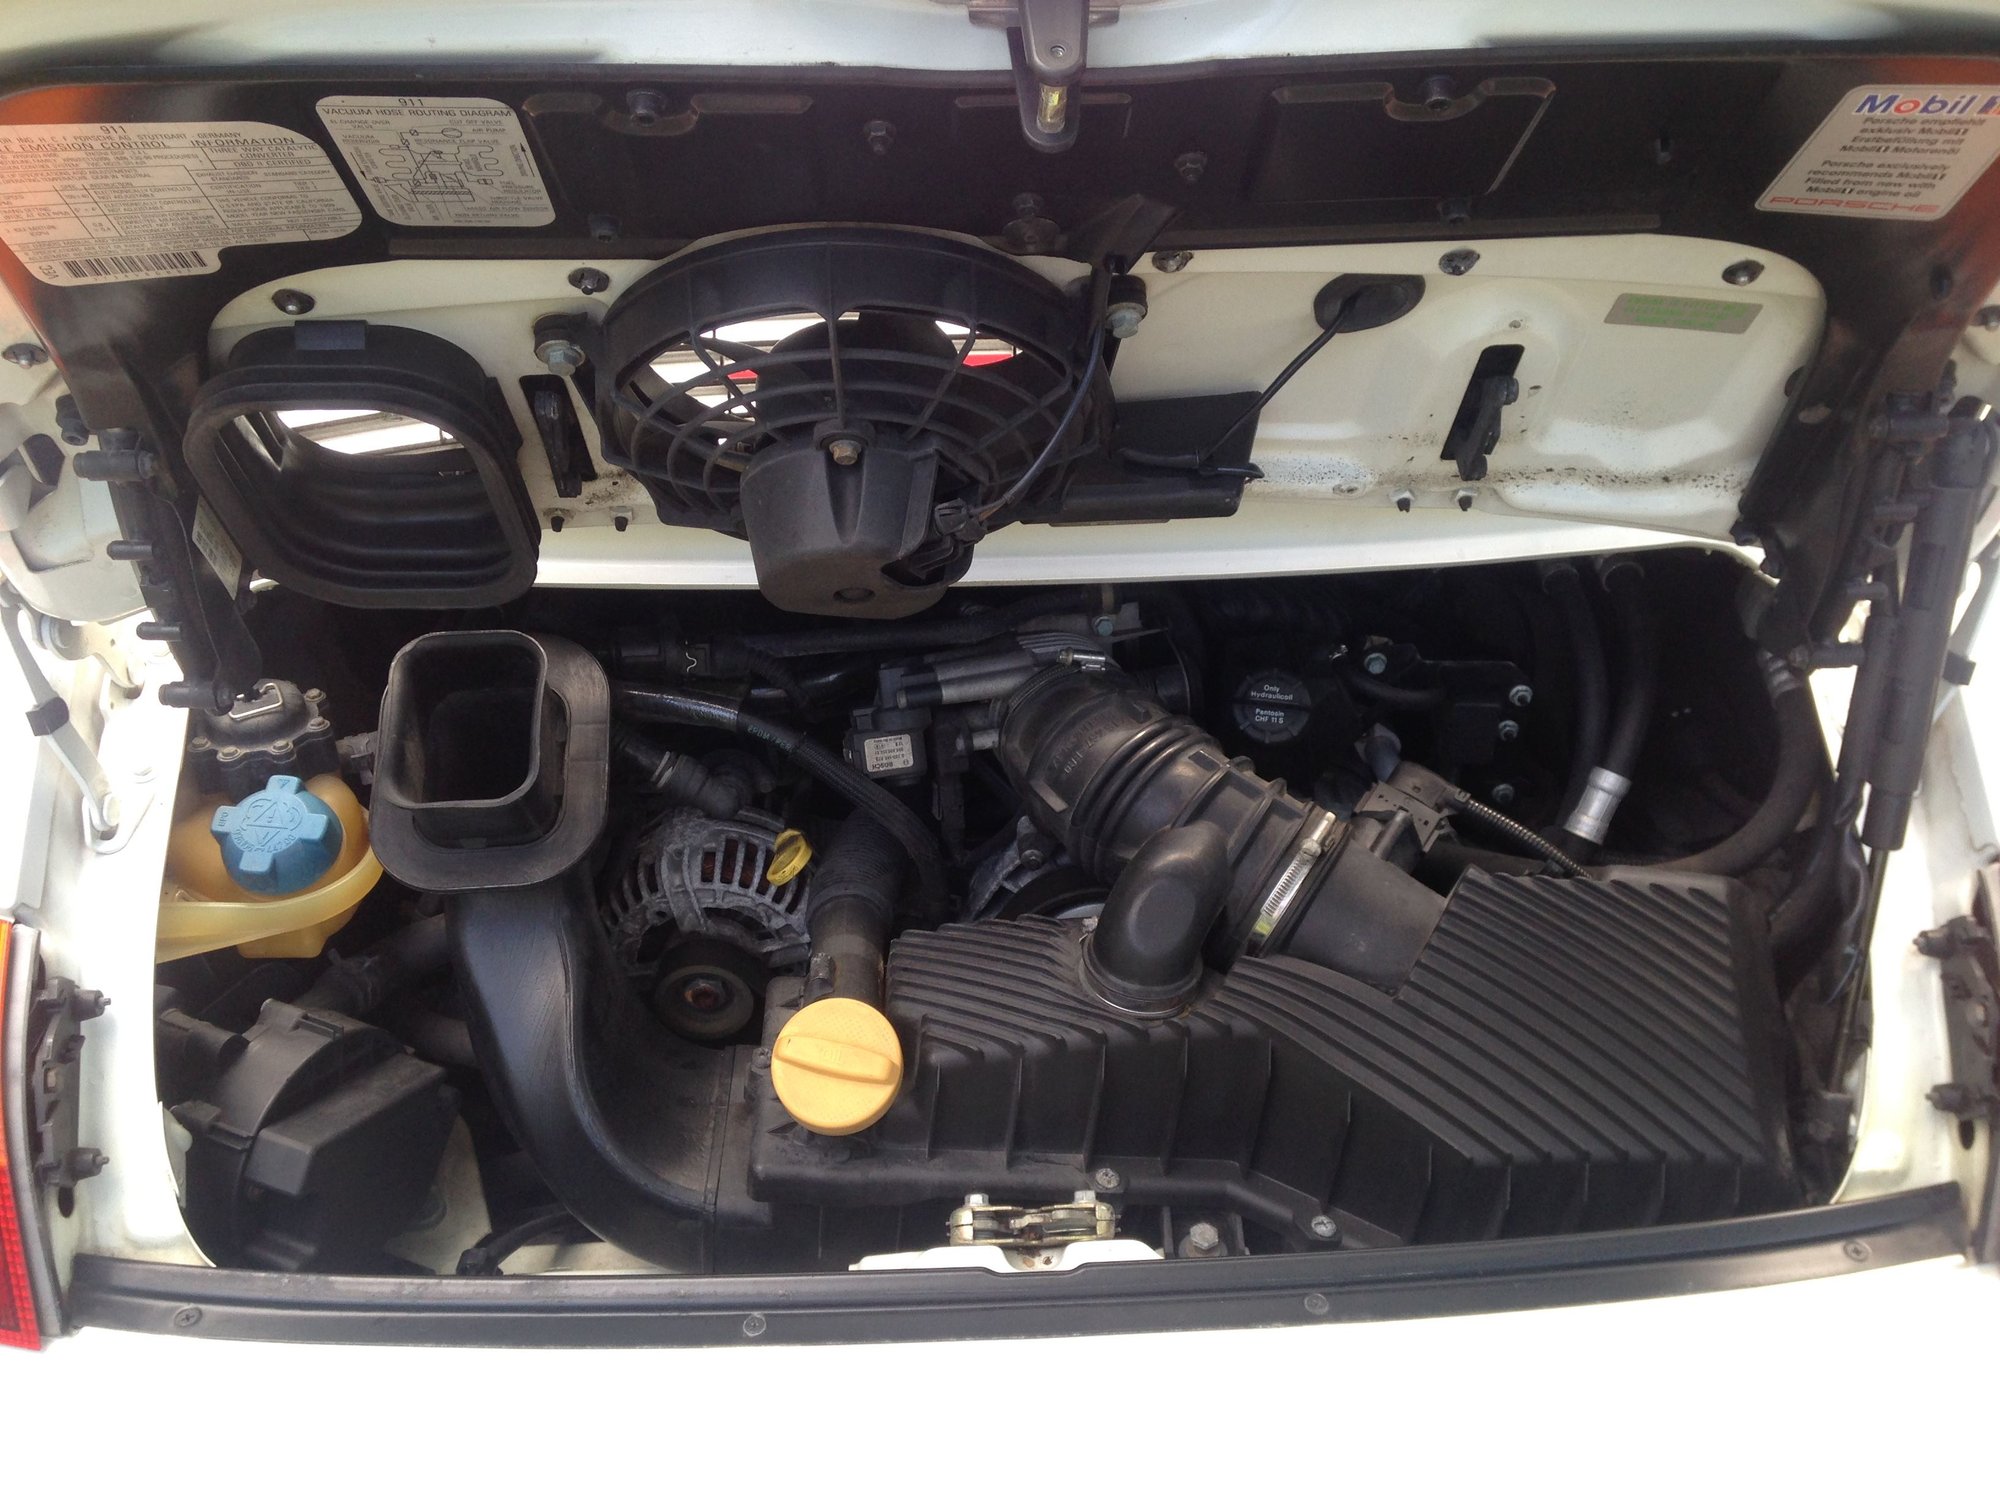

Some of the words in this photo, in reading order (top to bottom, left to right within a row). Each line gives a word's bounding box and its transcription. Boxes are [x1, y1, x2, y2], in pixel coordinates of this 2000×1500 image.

[397, 97, 424, 107] 911
[1855, 94, 1978, 114] Mobil
[322, 107, 373, 116] VACUUM
[375, 108, 405, 116] HOSE
[408, 109, 457, 117] ROUTING
[459, 109, 512, 117] DIAGRAM
[1863, 117, 1918, 125] Porsche
[99, 124, 127, 135] 911
[73, 134, 114, 142] PORSCHE
[136, 132, 187, 140] STUTTGART
[197, 131, 242, 139] GERMANY
[19, 142, 94, 152] EMISSION
[100, 140, 171, 150] CONTROL
[190, 137, 295, 149] INFORMATION
[209, 146, 239, 154] THREE
[242, 145, 264, 153] WAY
[267, 144, 319, 152] CATALYTIC
[239, 151, 295, 159] CONVERTER
[265, 159, 312, 167] CERTIFIED
[1821, 160, 1874, 168] Porsche
[1877, 162, 1949, 172] exclusively
[1807, 169, 1892, 178] recommends
[1804, 177, 1841, 185] Filled
[1908, 181, 1936, 189] with
[1856, 188, 1900, 197] engine
[1769, 196, 1942, 213] PORSCHE
[1263, 684, 1280, 692] Only
[1255, 708, 1285, 717] Pentosin
[1255, 715, 1269, 723] CHF
